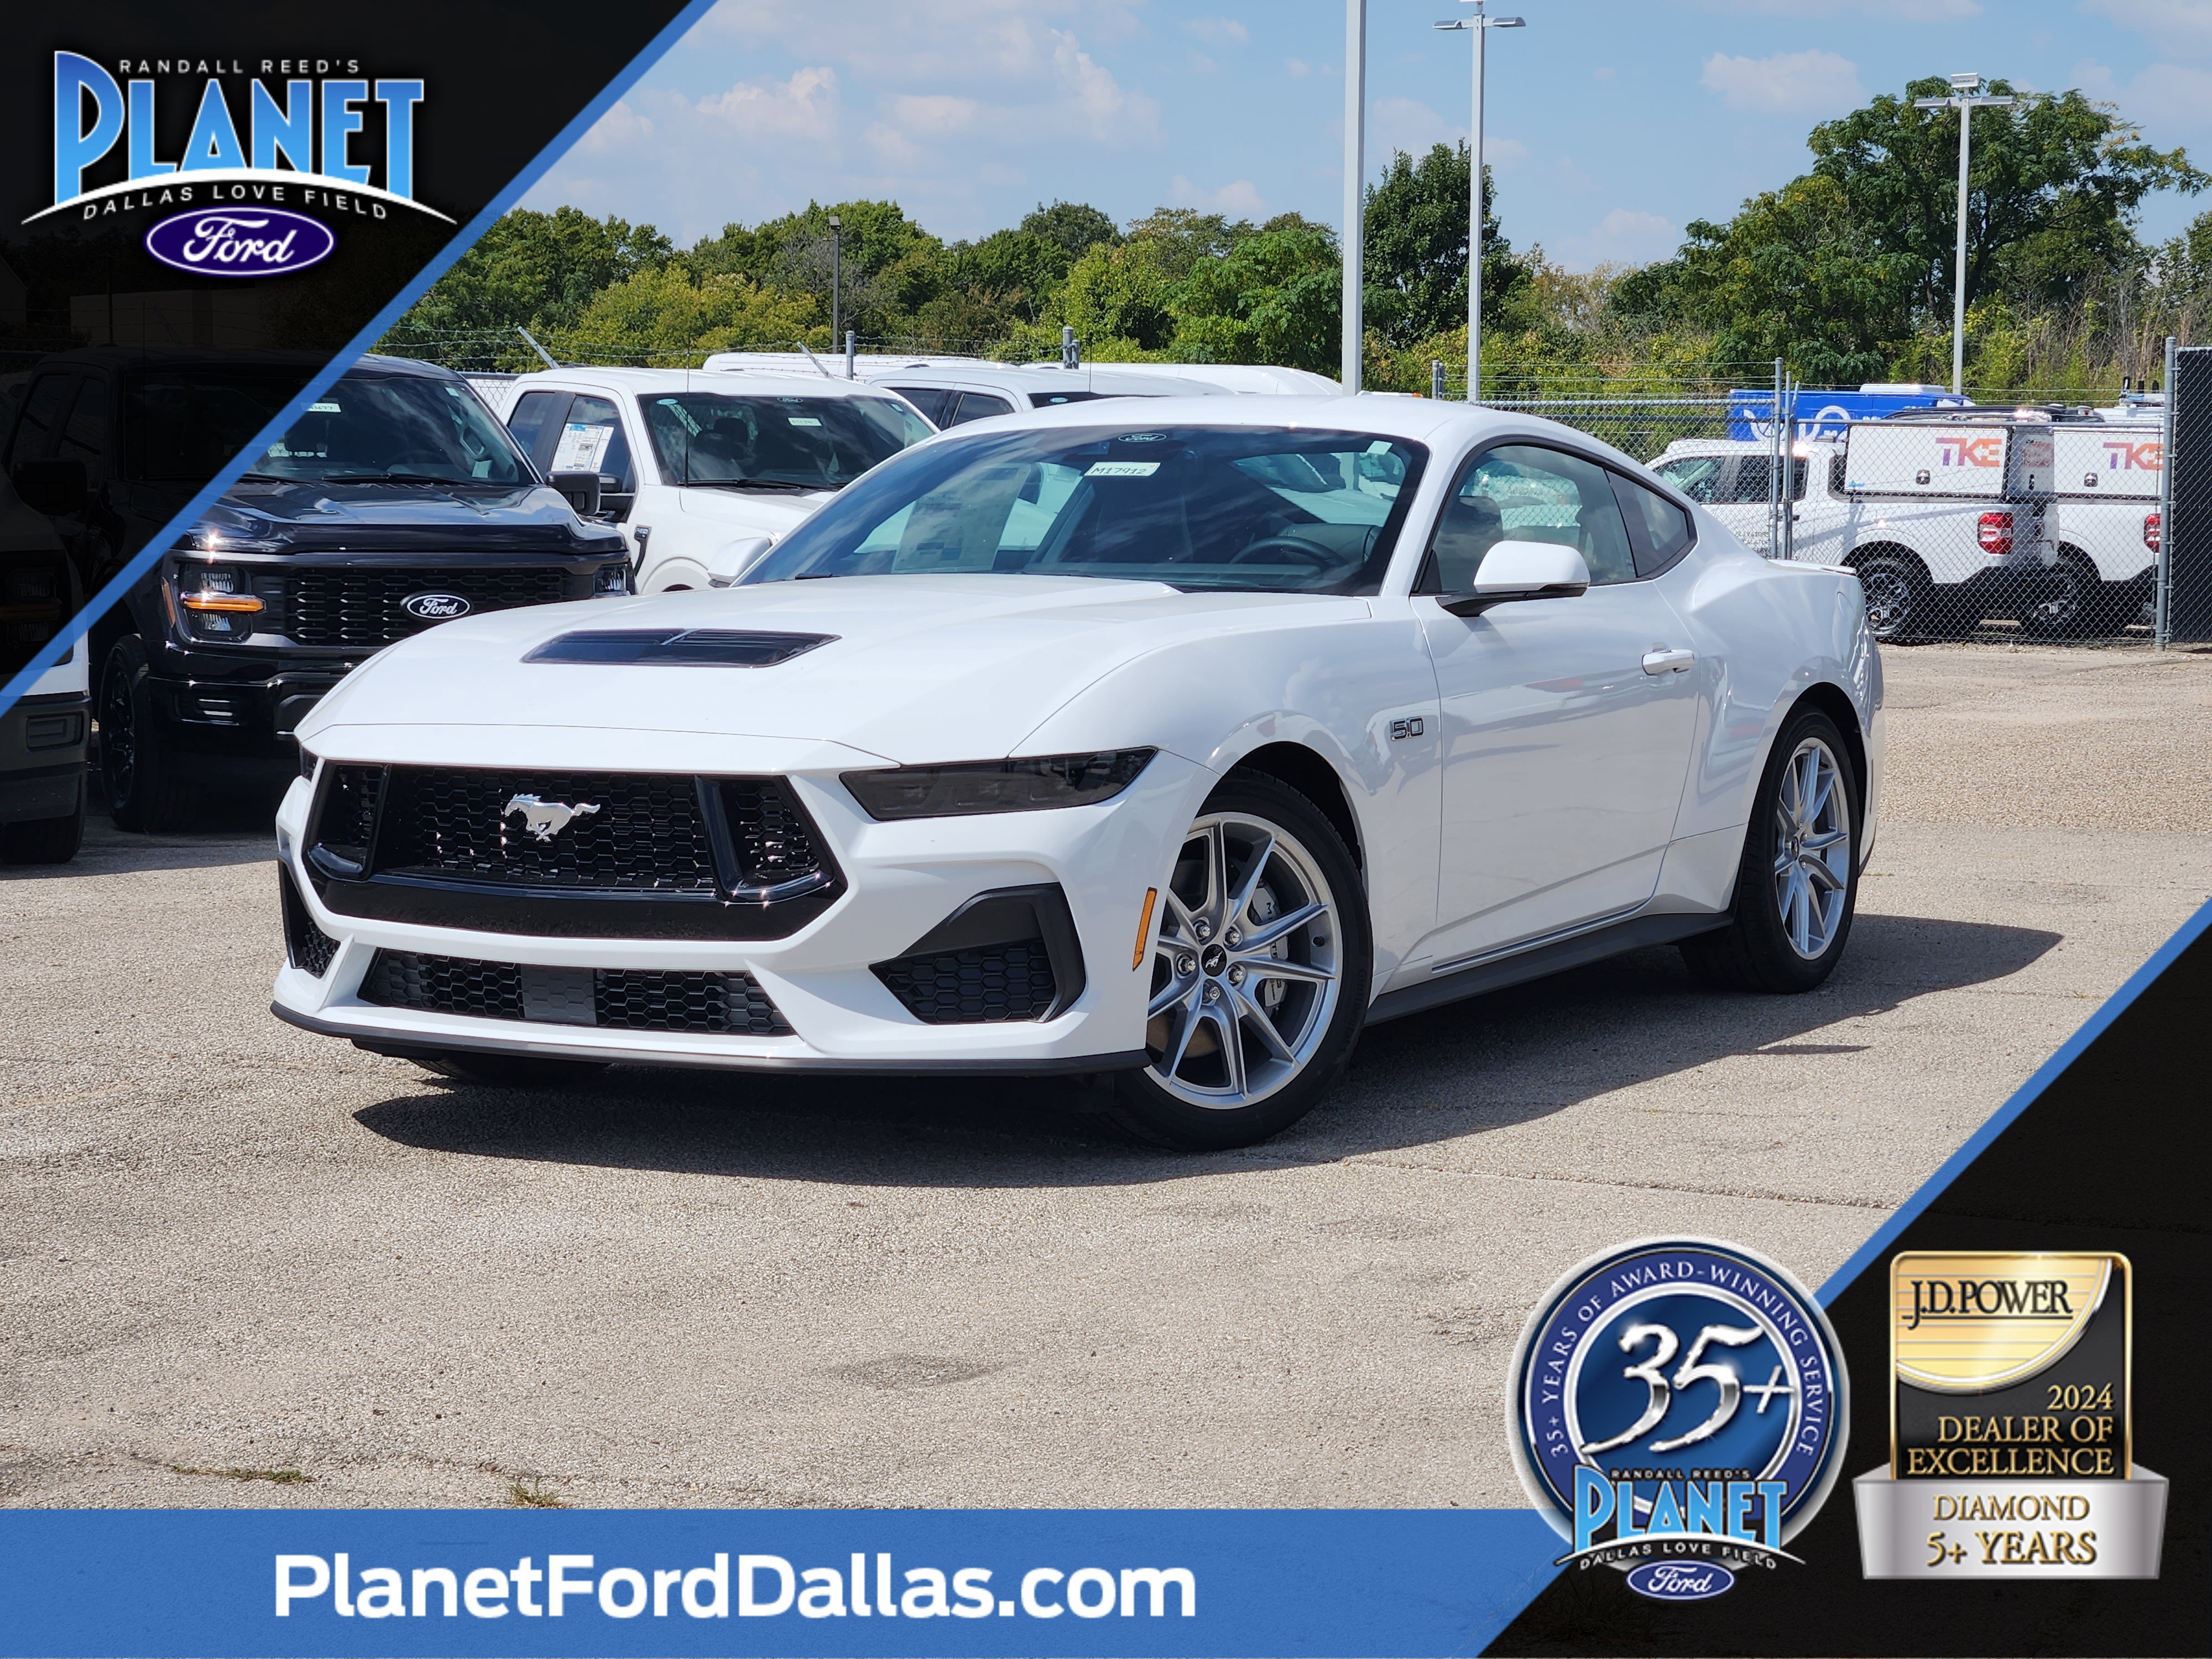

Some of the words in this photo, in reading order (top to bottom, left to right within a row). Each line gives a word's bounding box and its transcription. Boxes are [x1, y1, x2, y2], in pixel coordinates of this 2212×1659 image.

[1936, 437, 2002, 467] TKE
[420, 598, 458, 614] Ford
[1390, 717, 1424, 742] 5.0
